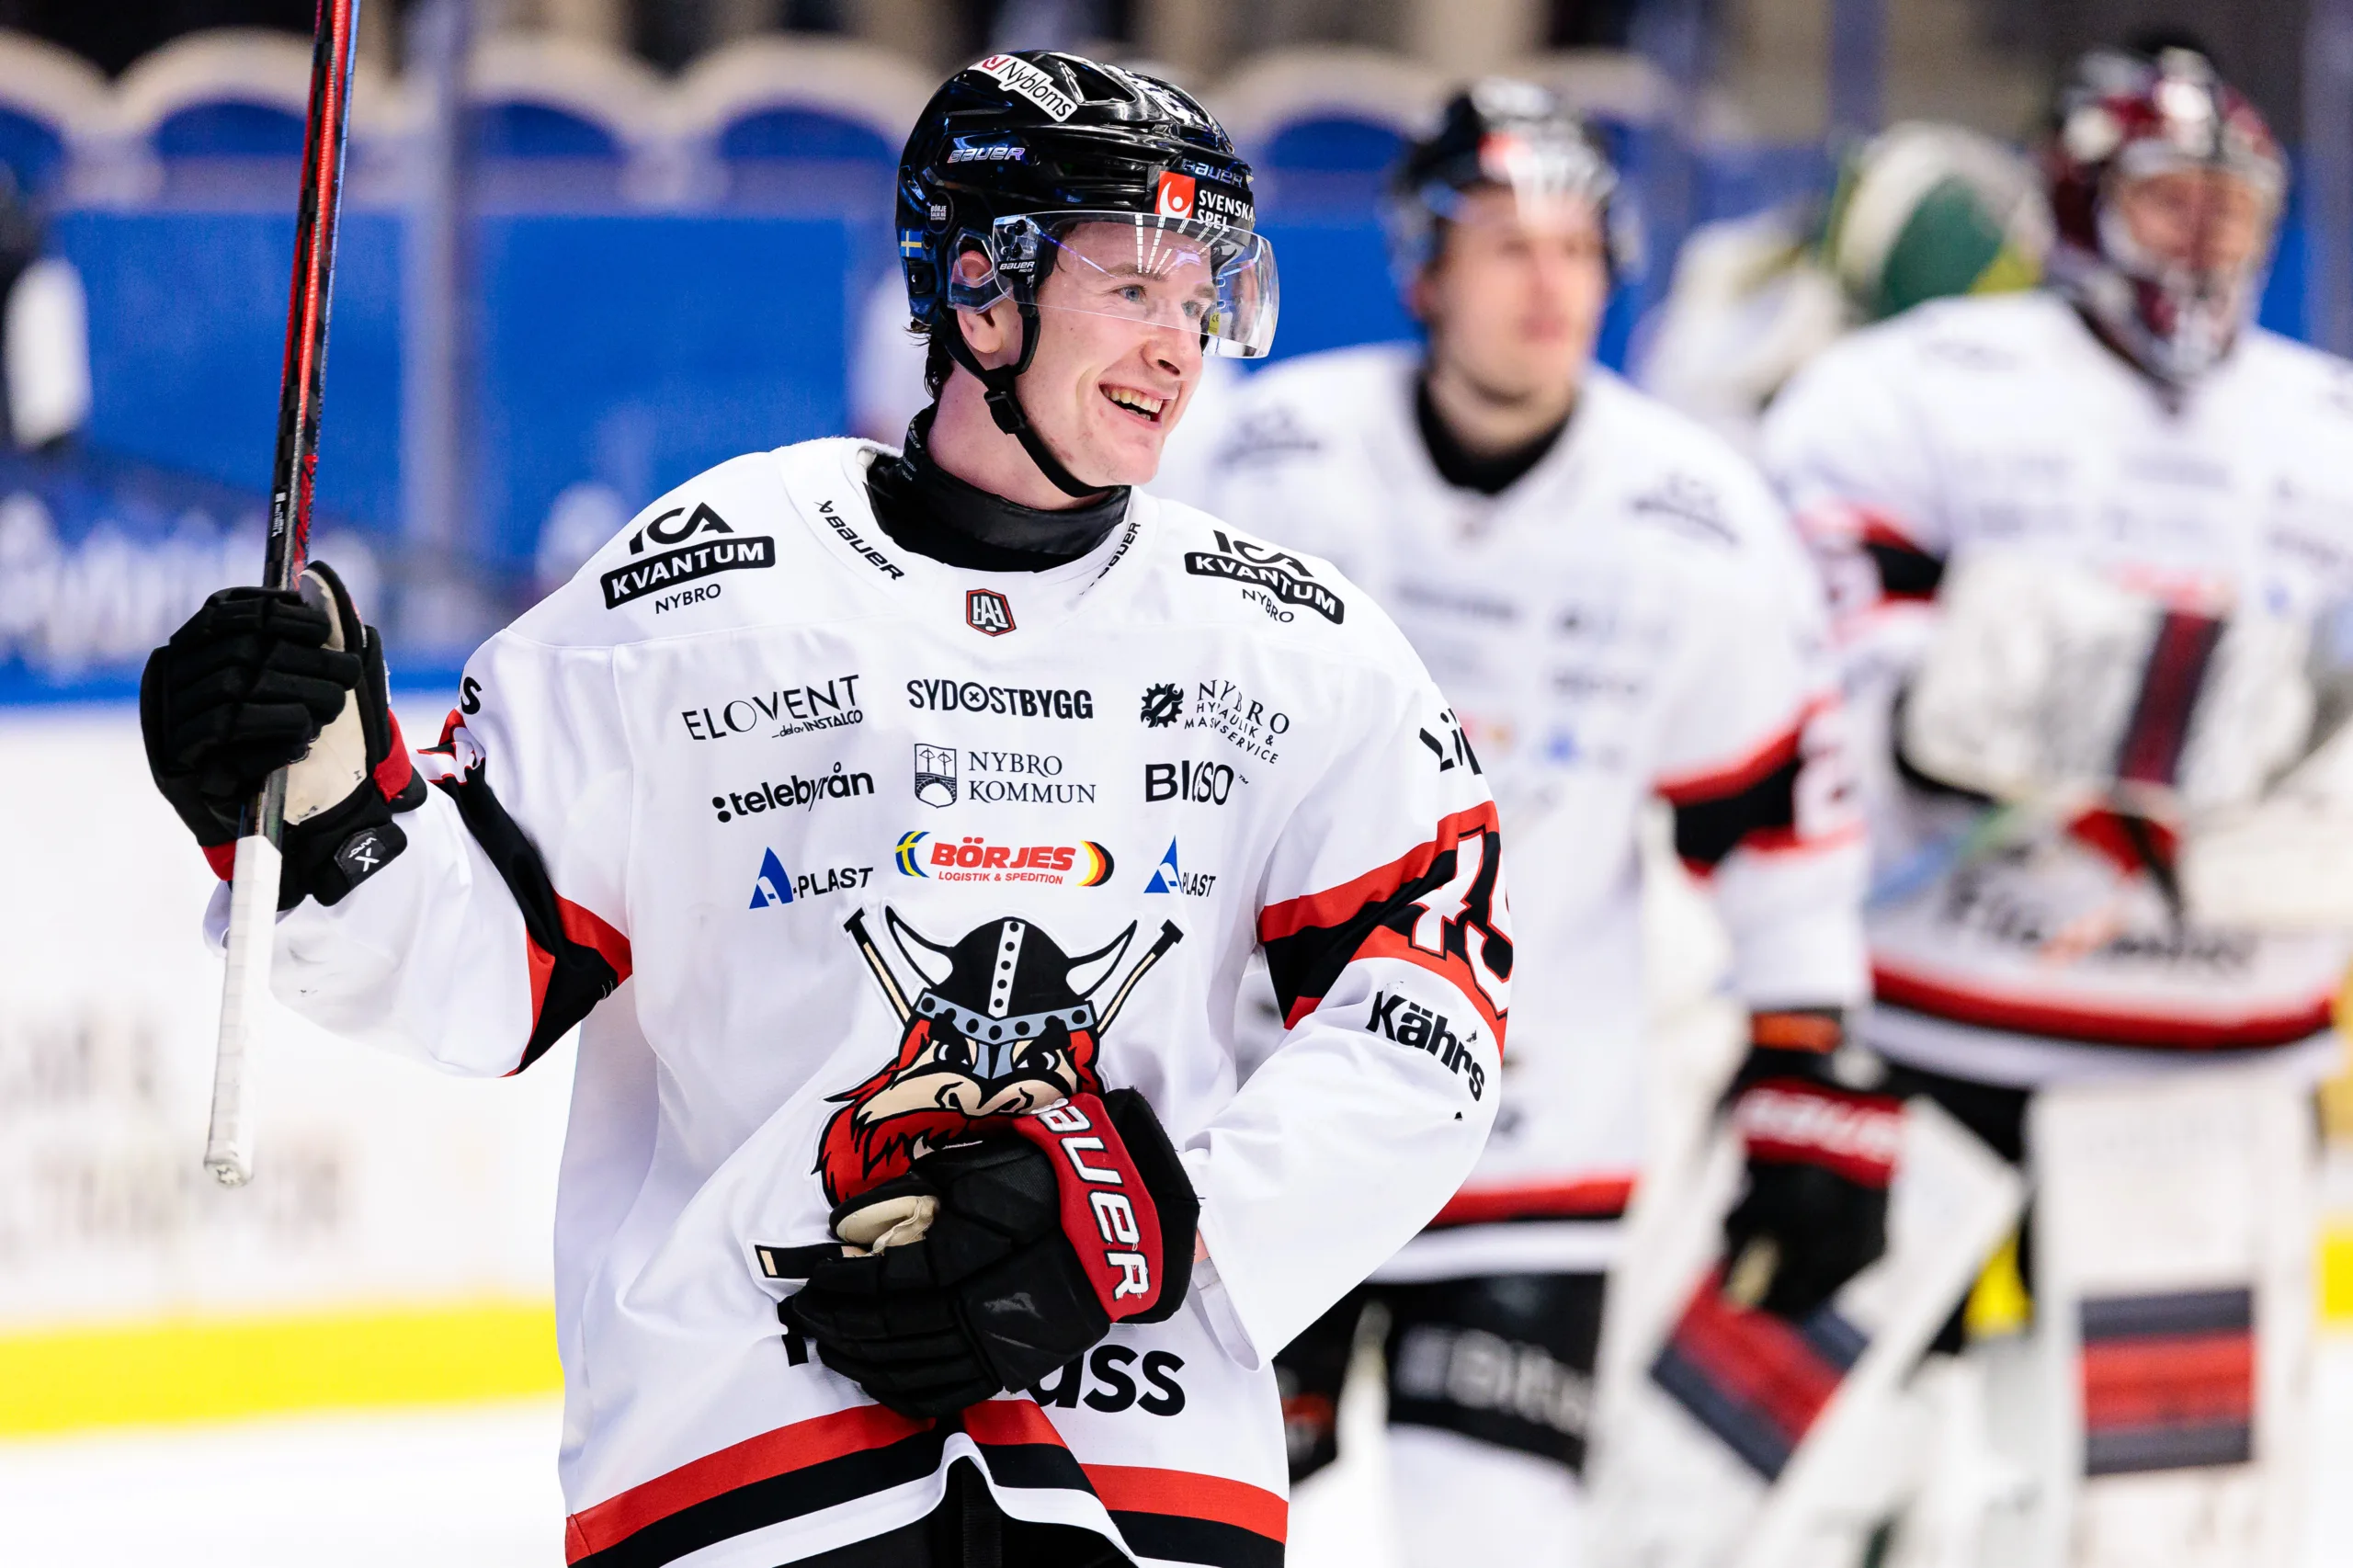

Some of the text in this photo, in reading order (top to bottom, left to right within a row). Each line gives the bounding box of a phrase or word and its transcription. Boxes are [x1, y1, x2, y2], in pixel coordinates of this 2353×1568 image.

[997, 61, 1072, 117] Nybloms
[1197, 209, 1230, 232] SPEL
[1199, 189, 1254, 222] SVENSKA
[999, 261, 1035, 270] BAUER
[629, 502, 734, 555] ICA
[824, 516, 904, 581] BAUER
[1213, 529, 1314, 577] ICA
[611, 542, 765, 599] KVANTUM
[1195, 556, 1336, 616] KVANTUM
[655, 584, 722, 614] NYBRO
[1242, 588, 1294, 623] NYBRO
[681, 674, 859, 740] ELOVENT
[802, 710, 863, 732] INSTALCO
[1265, 734, 1274, 746] &
[968, 751, 1063, 778] NYBRO
[968, 780, 1096, 804] KOMMUN
[930, 836, 1076, 871] BÖRJES
[938, 870, 1063, 885] LOGISTIK & SPEDITION
[1366, 990, 1485, 1102] Kährs
